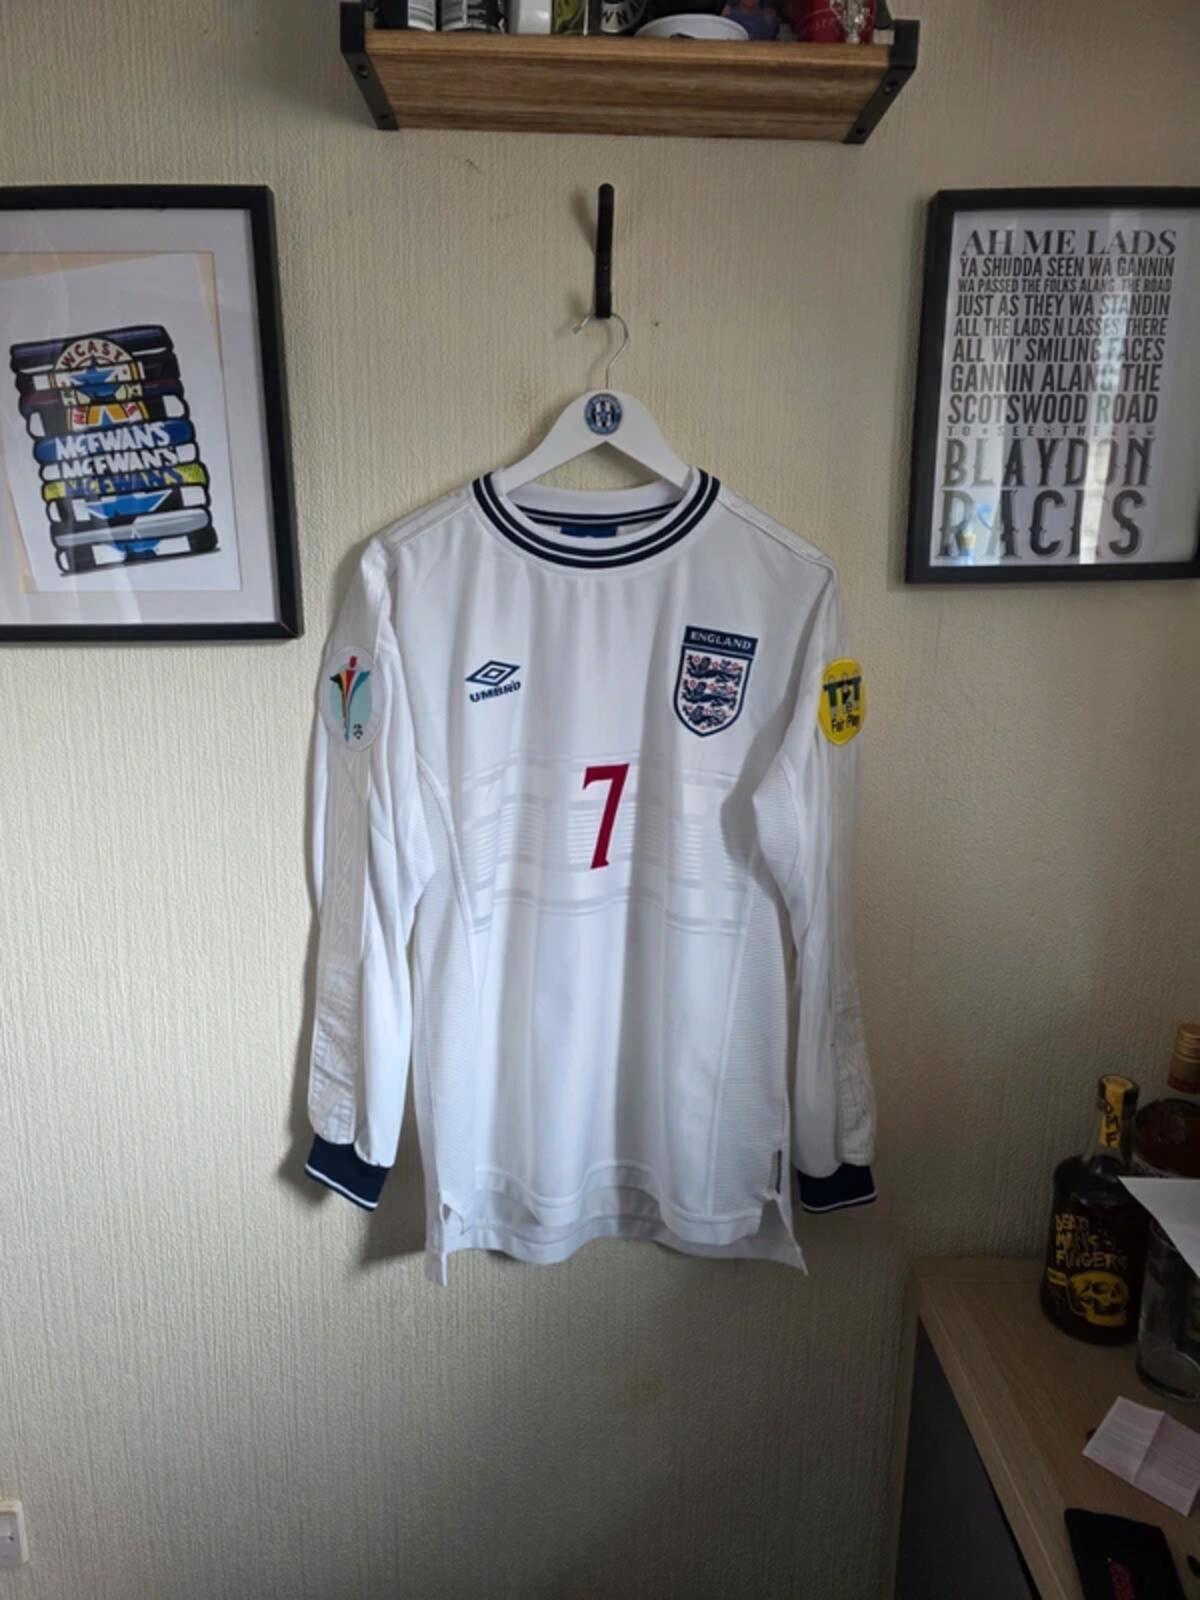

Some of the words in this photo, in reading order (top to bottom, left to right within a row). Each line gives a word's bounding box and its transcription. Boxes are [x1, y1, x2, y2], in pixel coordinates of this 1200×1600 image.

[961, 229, 1012, 256] AH
[1024, 229, 1076, 256] ME
[1087, 229, 1177, 256] LADS
[959, 257, 978, 277] YA
[982, 257, 1043, 277] SHUDDA
[1046, 257, 1084, 277] SEEN
[1089, 257, 1113, 277] WA
[1117, 257, 1175, 277] GANNIN
[957, 278, 975, 293] WA
[978, 278, 1018, 293] PASSED
[1021, 278, 1041, 293] THE
[1043, 278, 1076, 293] FOLKS
[1121, 278, 1141, 293] THE
[1143, 278, 1172, 293] ROAD
[955, 294, 995, 316] JUST
[998, 294, 1019, 316] AS
[1024, 294, 1065, 316] THEY
[1069, 294, 1095, 316] WA
[1100, 294, 1171, 316] STANDIN
[954, 317, 980, 337] ALL
[984, 317, 1010, 337] THE
[1013, 317, 1049, 337] LADS
[1053, 317, 1064, 337] N
[1068, 317, 1120, 337] LASSES
[1125, 317, 1167, 337] THERE
[952, 338, 985, 362] ALL
[992, 338, 1021, 362] WI'
[1025, 338, 1101, 362] SMILING
[1107, 338, 1165, 362] FACES
[950, 364, 1035, 392] GANNIN
[1040, 364, 1114, 392] ALANG
[1123, 364, 1160, 392] THE
[947, 394, 1088, 425] SCOTSWOOD
[1095, 394, 1158, 425] ROAD
[947, 426, 970, 436] TO
[997, 426, 1034, 436] SEE
[1062, 426, 1099, 436] THE
[942, 438, 1155, 487] BLAYDON
[689, 630, 752, 650] ENGLAND
[469, 680, 522, 703] UMBRO
[582, 763, 630, 870] 7
